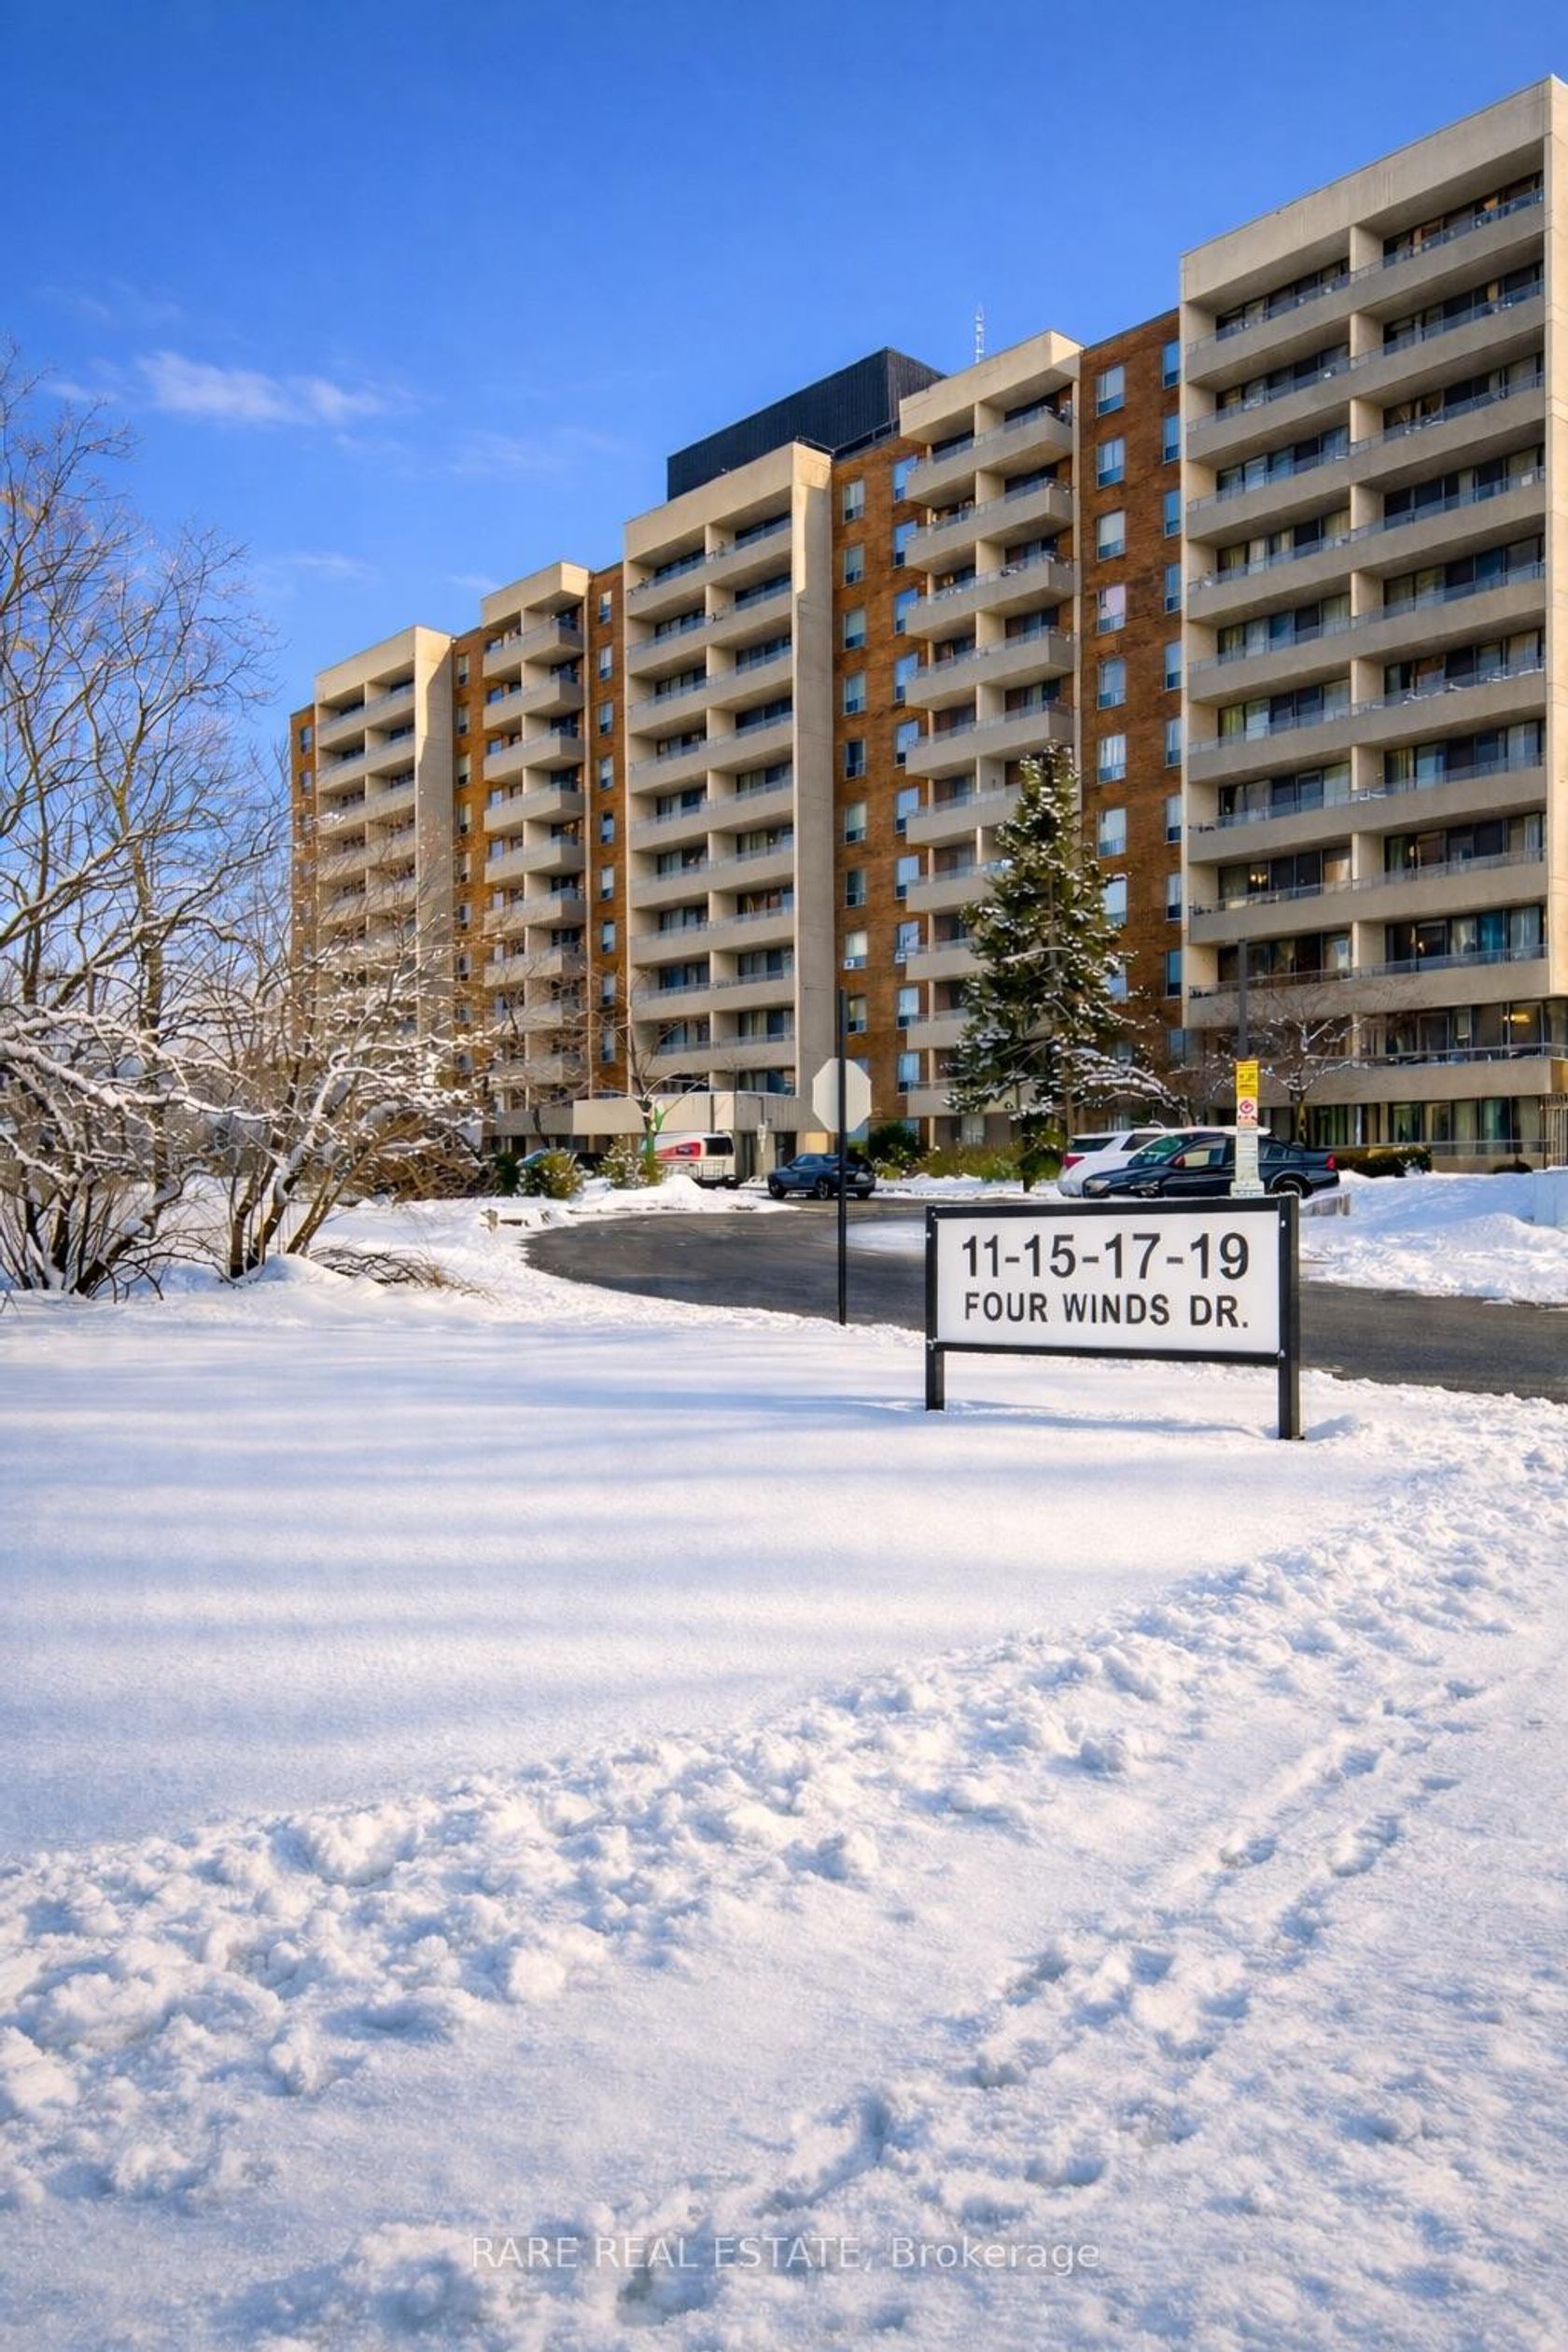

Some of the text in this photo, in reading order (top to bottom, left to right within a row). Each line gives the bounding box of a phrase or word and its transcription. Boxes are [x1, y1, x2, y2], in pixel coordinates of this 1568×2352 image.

[961, 1232, 1250, 1281] 11-15-17-19
[964, 1291, 1249, 1328] FOUR WINDS DR.
